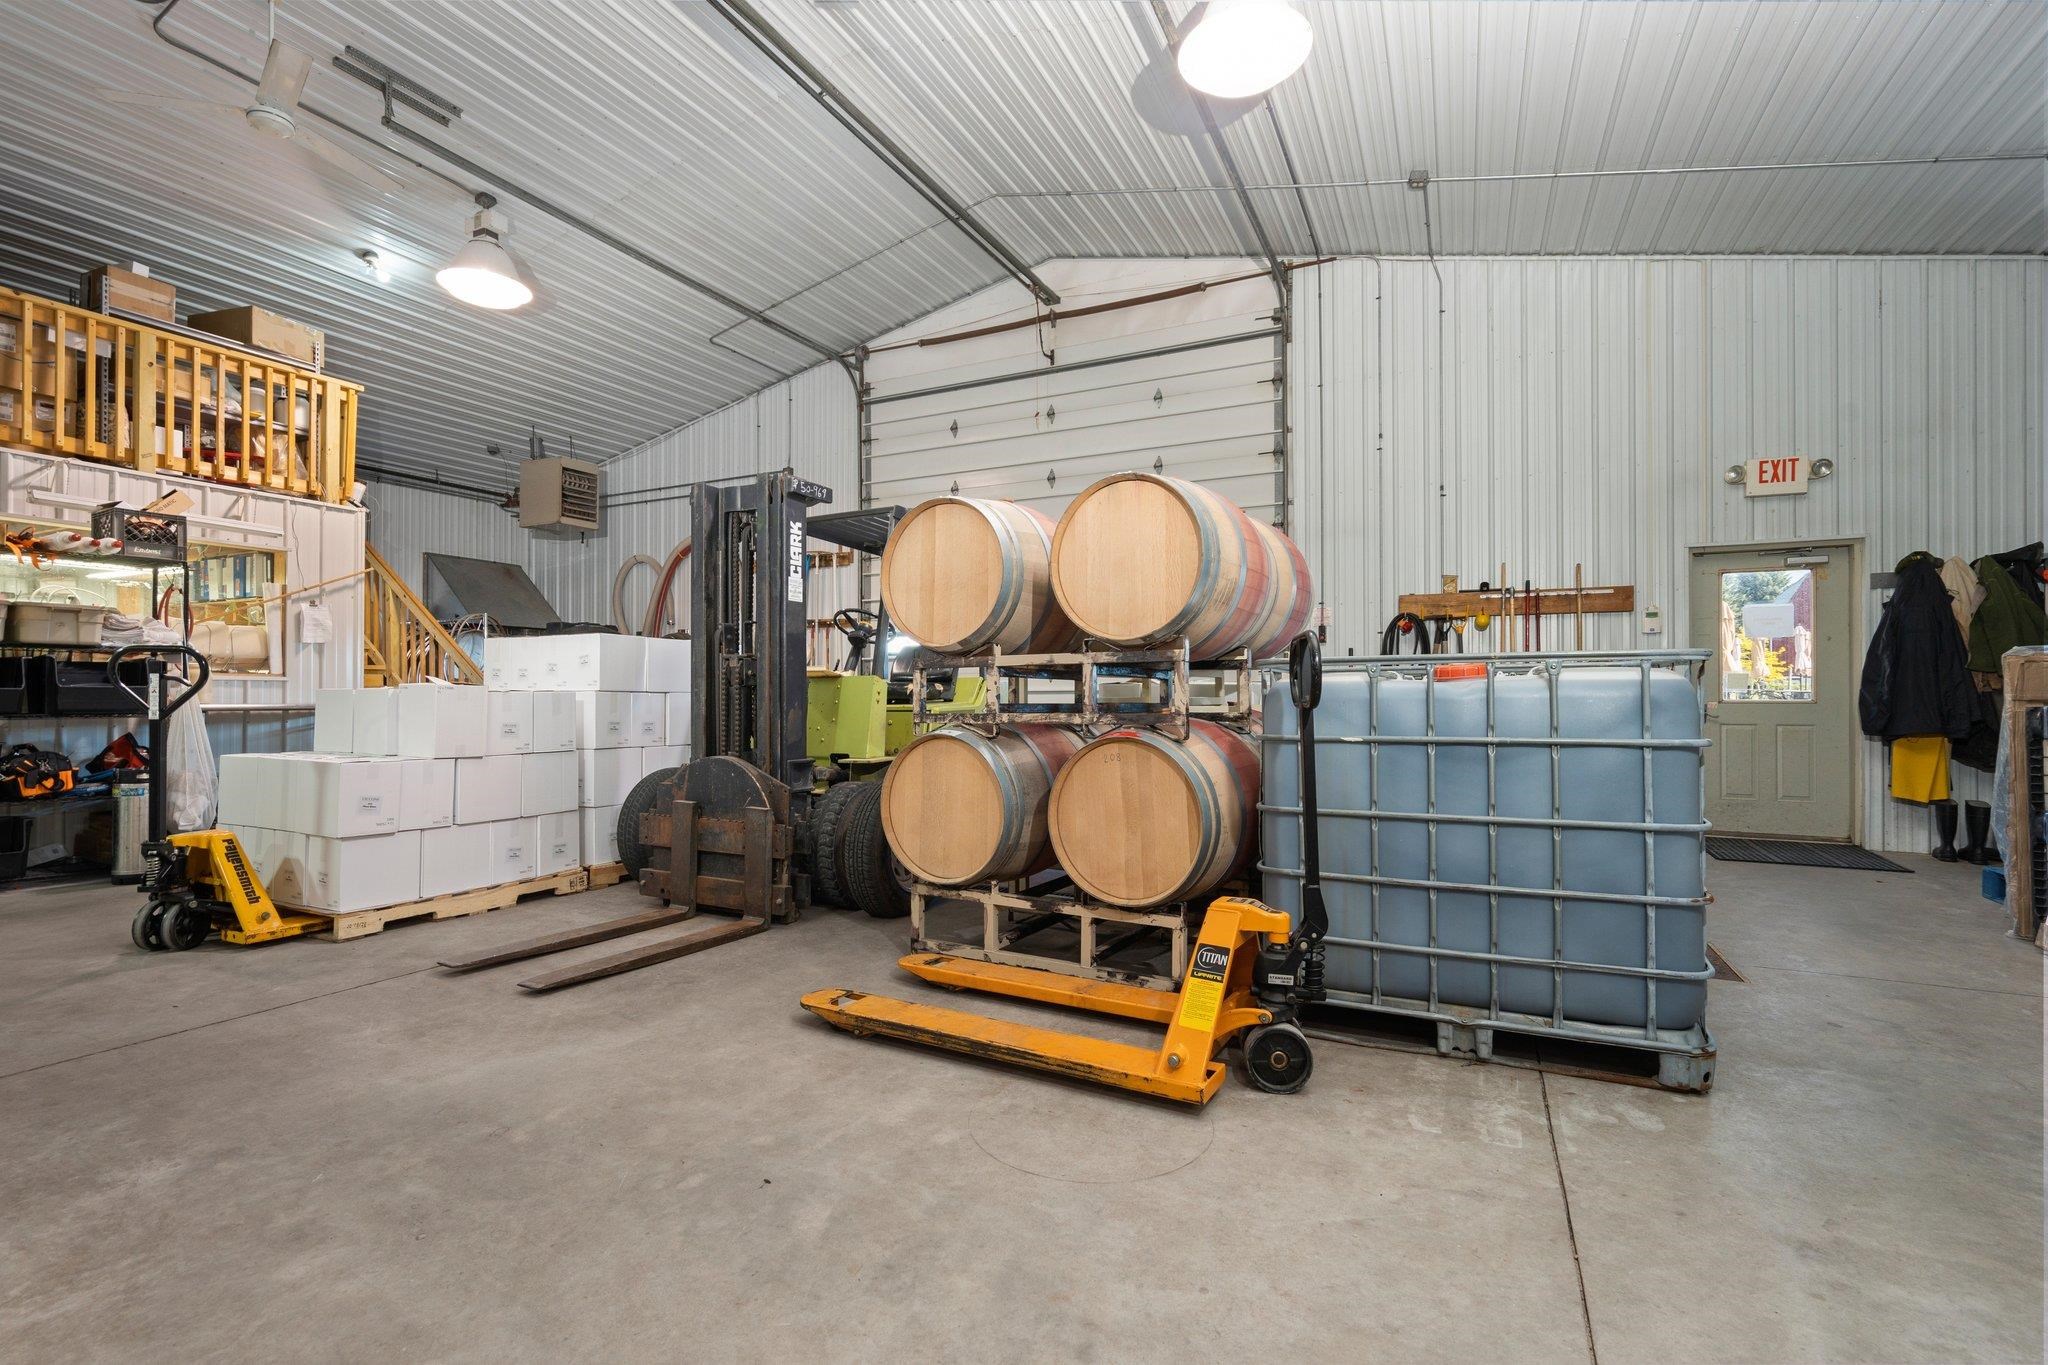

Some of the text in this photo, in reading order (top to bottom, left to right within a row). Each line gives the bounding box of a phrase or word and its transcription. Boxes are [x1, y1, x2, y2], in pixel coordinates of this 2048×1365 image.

[1759, 458, 1799, 484] EXIT
[789, 520, 803, 580] CLARK
[1202, 951, 1228, 967] TITAN
